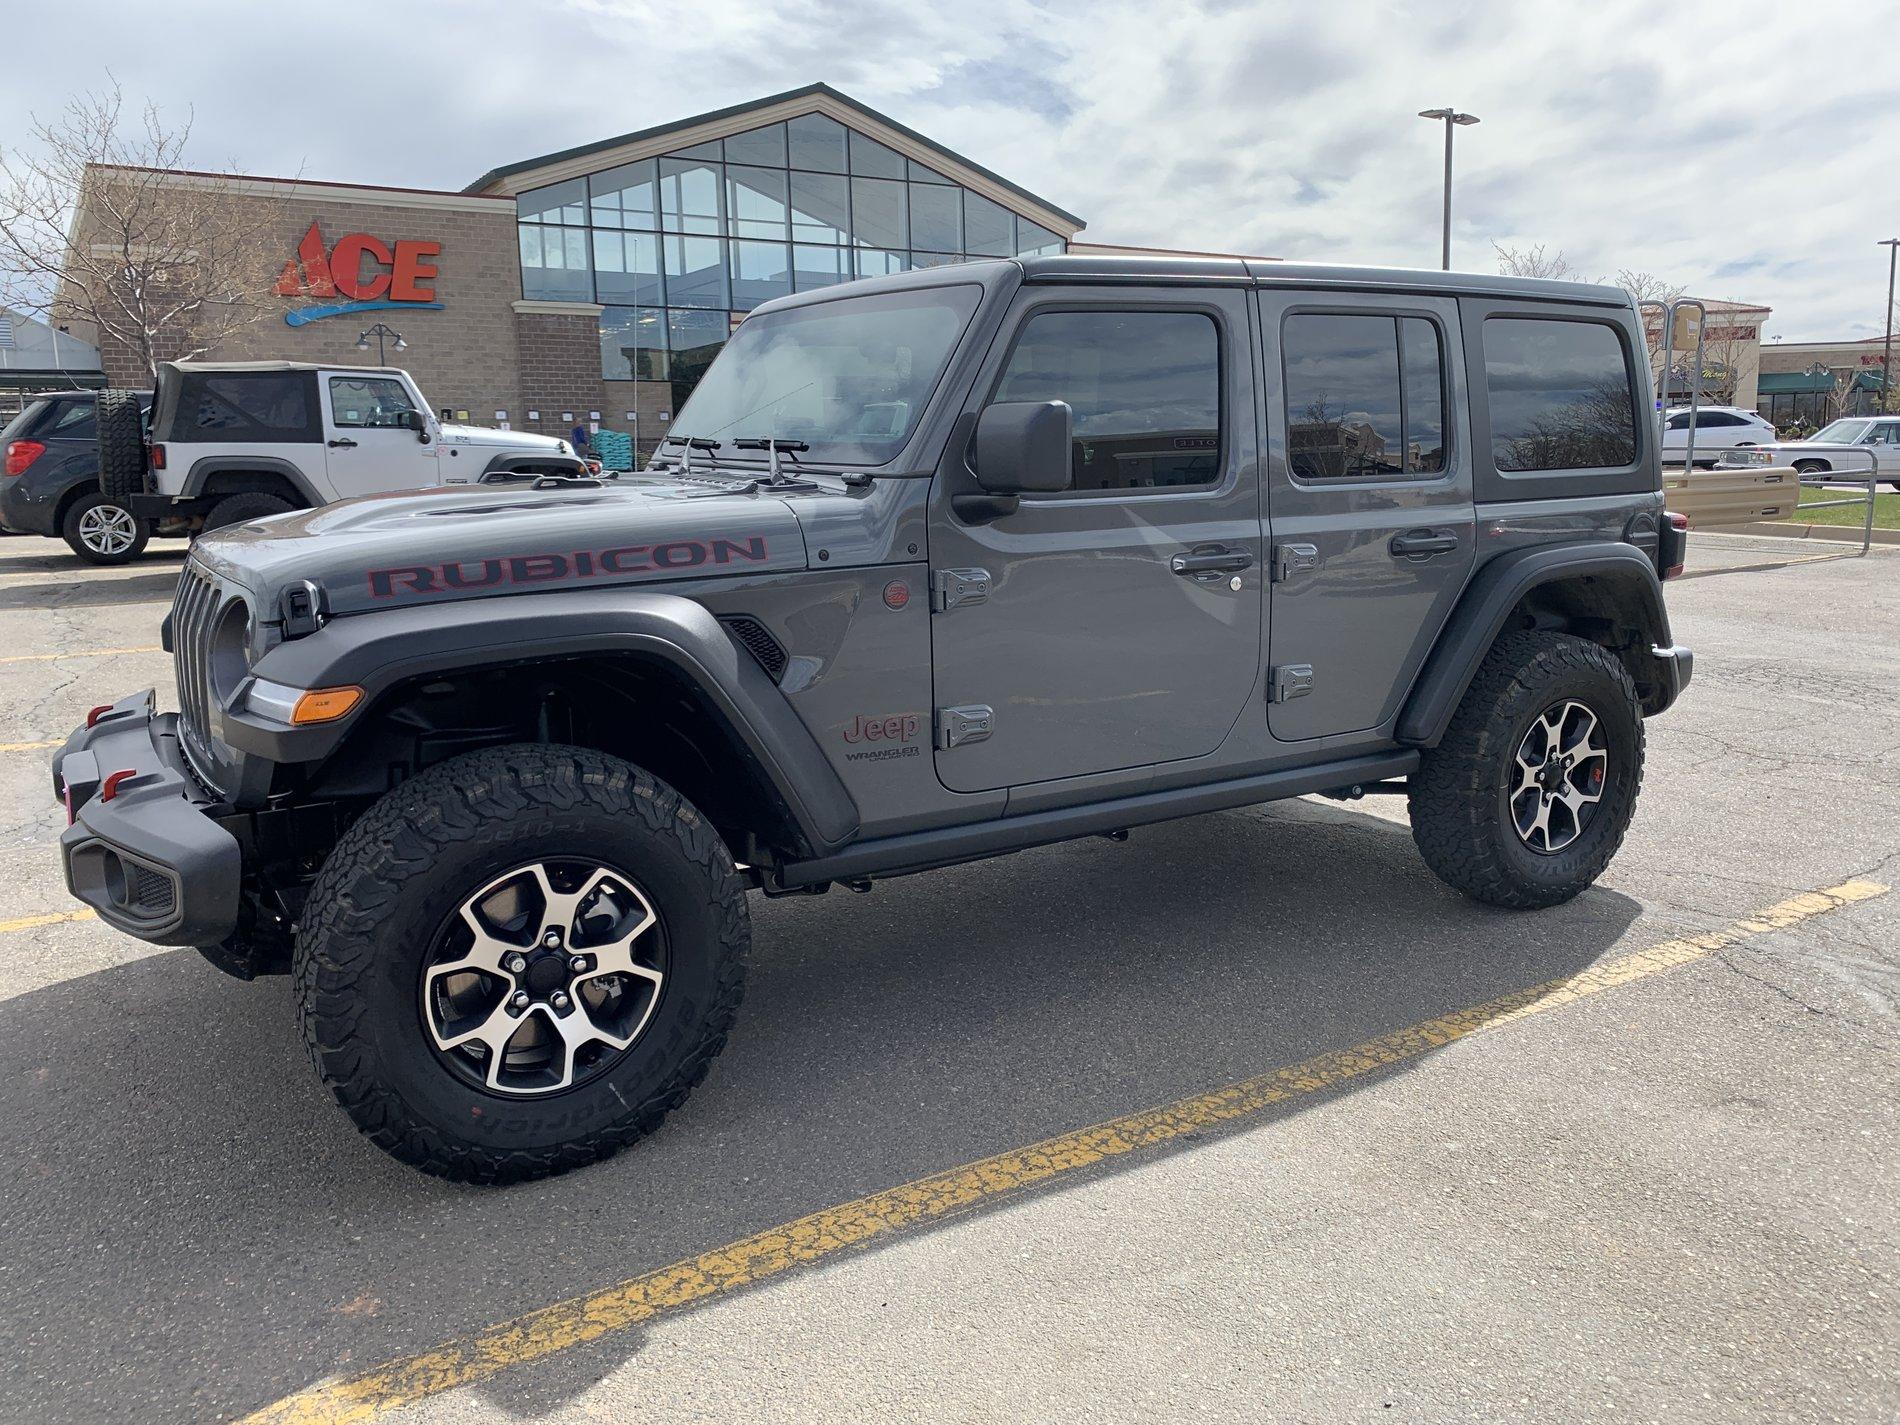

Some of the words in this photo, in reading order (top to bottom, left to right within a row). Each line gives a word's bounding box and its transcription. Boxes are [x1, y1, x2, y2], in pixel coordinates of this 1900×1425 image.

[273, 220, 441, 301] ACE
[368, 536, 769, 599] RUBICON
[843, 713, 921, 744] Jeep
[844, 746, 920, 762] WRANGLER
